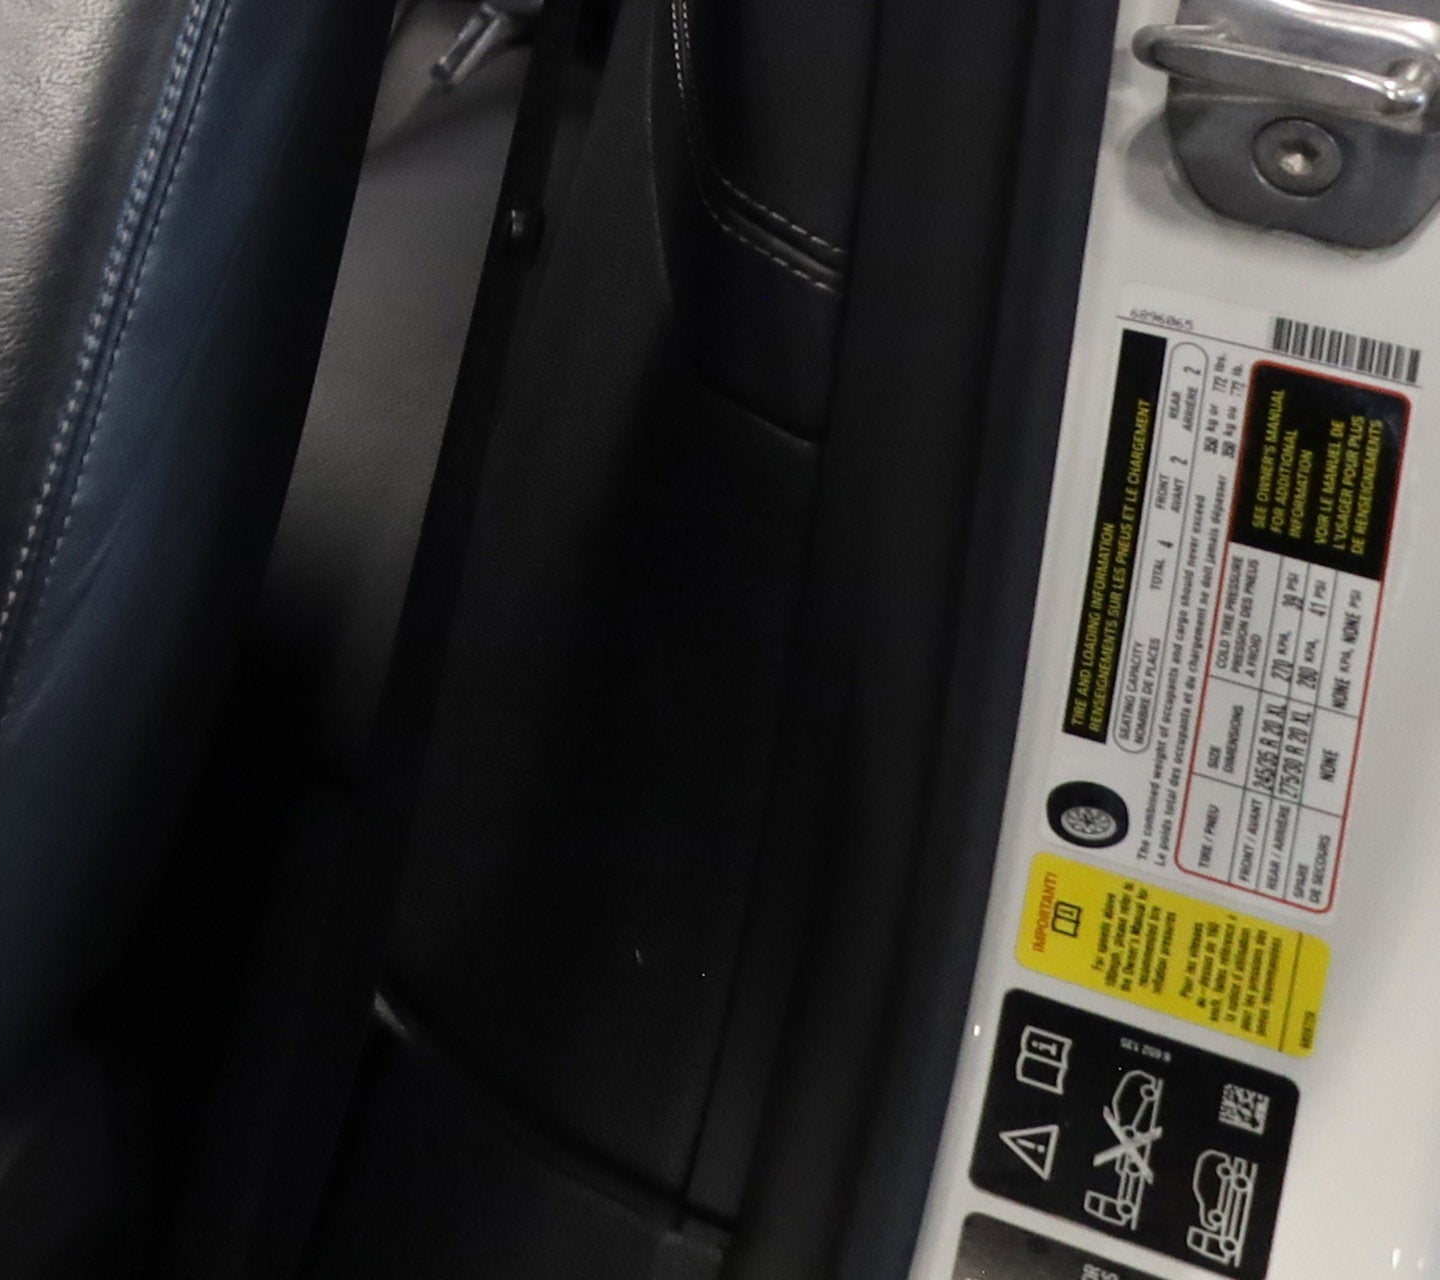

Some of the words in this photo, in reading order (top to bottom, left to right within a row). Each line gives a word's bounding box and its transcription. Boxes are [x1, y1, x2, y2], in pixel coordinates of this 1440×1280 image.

[1183, 365, 1201, 376] 2
[1215, 353, 1226, 372] lbs.
[1233, 362, 1243, 377] lb.
[1168, 391, 1181, 419] REAR
[1210, 404, 1218, 416] or
[1228, 406, 1236, 420] ou
[1265, 388, 1285, 443] MANUAL
[1206, 418, 1218, 433] kg
[1224, 422, 1235, 437] kg
[1330, 419, 1345, 438] DE
[1348, 414, 1365, 449] PLUS
[1127, 398, 1151, 485] CHARGEMENT
[1170, 455, 1188, 466] 2
[1256, 443, 1276, 503] OWNER'S
[1274, 427, 1298, 505] ADDITIONAL
[1322, 439, 1342, 494] MANUEL
[1342, 450, 1359, 487] POUR
[1155, 473, 1169, 510] FRONT
[1354, 418, 1383, 535] RENSEIGNEMENTS
[1125, 486, 1138, 503] LE
[1170, 478, 1184, 513] AVANT
[1289, 449, 1313, 539] INFORMATION
[1320, 496, 1333, 512] LE
[1122, 504, 1135, 521] ET
[1191, 494, 1205, 533] exceed
[1252, 505, 1267, 529] SEE
[1270, 507, 1285, 533] FOR
[1333, 487, 1354, 550] L'USAGER
[1115, 523, 1132, 565] PNEUS
[1157, 539, 1173, 549] 4
[1315, 513, 1330, 545] VOIR
[1188, 537, 1199, 567] never
[1205, 527, 1220, 564] jamais
[1351, 536, 1365, 555] DE
[1090, 522, 1114, 610] INFORMATION
[1112, 566, 1126, 590] LES
[1151, 558, 1165, 591] TOTAL
[1201, 566, 1212, 588] doit
[1243, 558, 1259, 595] PNEUS
[1180, 569, 1194, 607] should
[1200, 592, 1209, 605] ne
[1225, 556, 1243, 612] PRESSURE
[1313, 579, 1326, 600] PSI
[1349, 589, 1362, 610] PSI
[1107, 591, 1122, 617] SUR
[1240, 596, 1253, 619] DES
[1308, 601, 1327, 618] 41
[1081, 611, 1101, 667] LOADING
[1176, 610, 1189, 641] cargo
[1188, 607, 1208, 673] chargement
[1221, 614, 1234, 637] TIRE
[1271, 657, 1293, 683] 270
[1286, 572, 1299, 592] PSI
[1341, 611, 1361, 645] NONE
[1145, 637, 1160, 678] PLACES
[1172, 643, 1182, 664] and
[1216, 639, 1230, 670] COLD
[1231, 619, 1249, 674] PRESSION
[1246, 633, 1261, 667] FROID
[1089, 618, 1118, 733] RENSEIGNEMENTS
[1126, 640, 1144, 693] CAPACITY
[1296, 665, 1317, 690] 280
[1077, 668, 1092, 697] AND
[1142, 680, 1153, 695] DE
[1161, 667, 1179, 723] occupants
[1184, 692, 1193, 704] et
[1186, 675, 1196, 690] du
[1331, 677, 1351, 710] NONE
[1072, 697, 1087, 727] TIRE
[1119, 695, 1135, 741] SEATING
[1134, 696, 1150, 745] NOMBRE
[1265, 701, 1287, 718] XL
[1291, 709, 1311, 727] XL
[1158, 725, 1168, 738] of
[1173, 707, 1191, 765] occupants
[1223, 704, 1244, 774] DIMENSIONS
[1260, 737, 1280, 748] R
[1262, 718, 1283, 737] 20
[1288, 726, 1308, 744] 20
[1152, 740, 1168, 780] weight
[1208, 744, 1221, 769] SIZE
[1285, 744, 1304, 757] R
[1318, 747, 1338, 783] NONE
[1169, 767, 1180, 788] des
[1252, 749, 1279, 792] 245/35
[1278, 756, 1303, 800] 275/30
[1142, 781, 1159, 836] combined
[1164, 789, 1176, 816] total
[1137, 839, 1149, 860] The
[1159, 818, 1173, 851] poids
[1198, 844, 1211, 869] TIRE
[1205, 803, 1219, 835] PNEU
[1239, 844, 1255, 882] FRONT
[1247, 798, 1262, 835] AVANT
[1155, 852, 1166, 867] Le
[1312, 834, 1330, 886] SECOURS
[1267, 860, 1280, 891] REAR
[1292, 862, 1308, 899] SPARE
[1309, 888, 1321, 904] DE
[1032, 871, 1059, 953] IMPORTANT!
